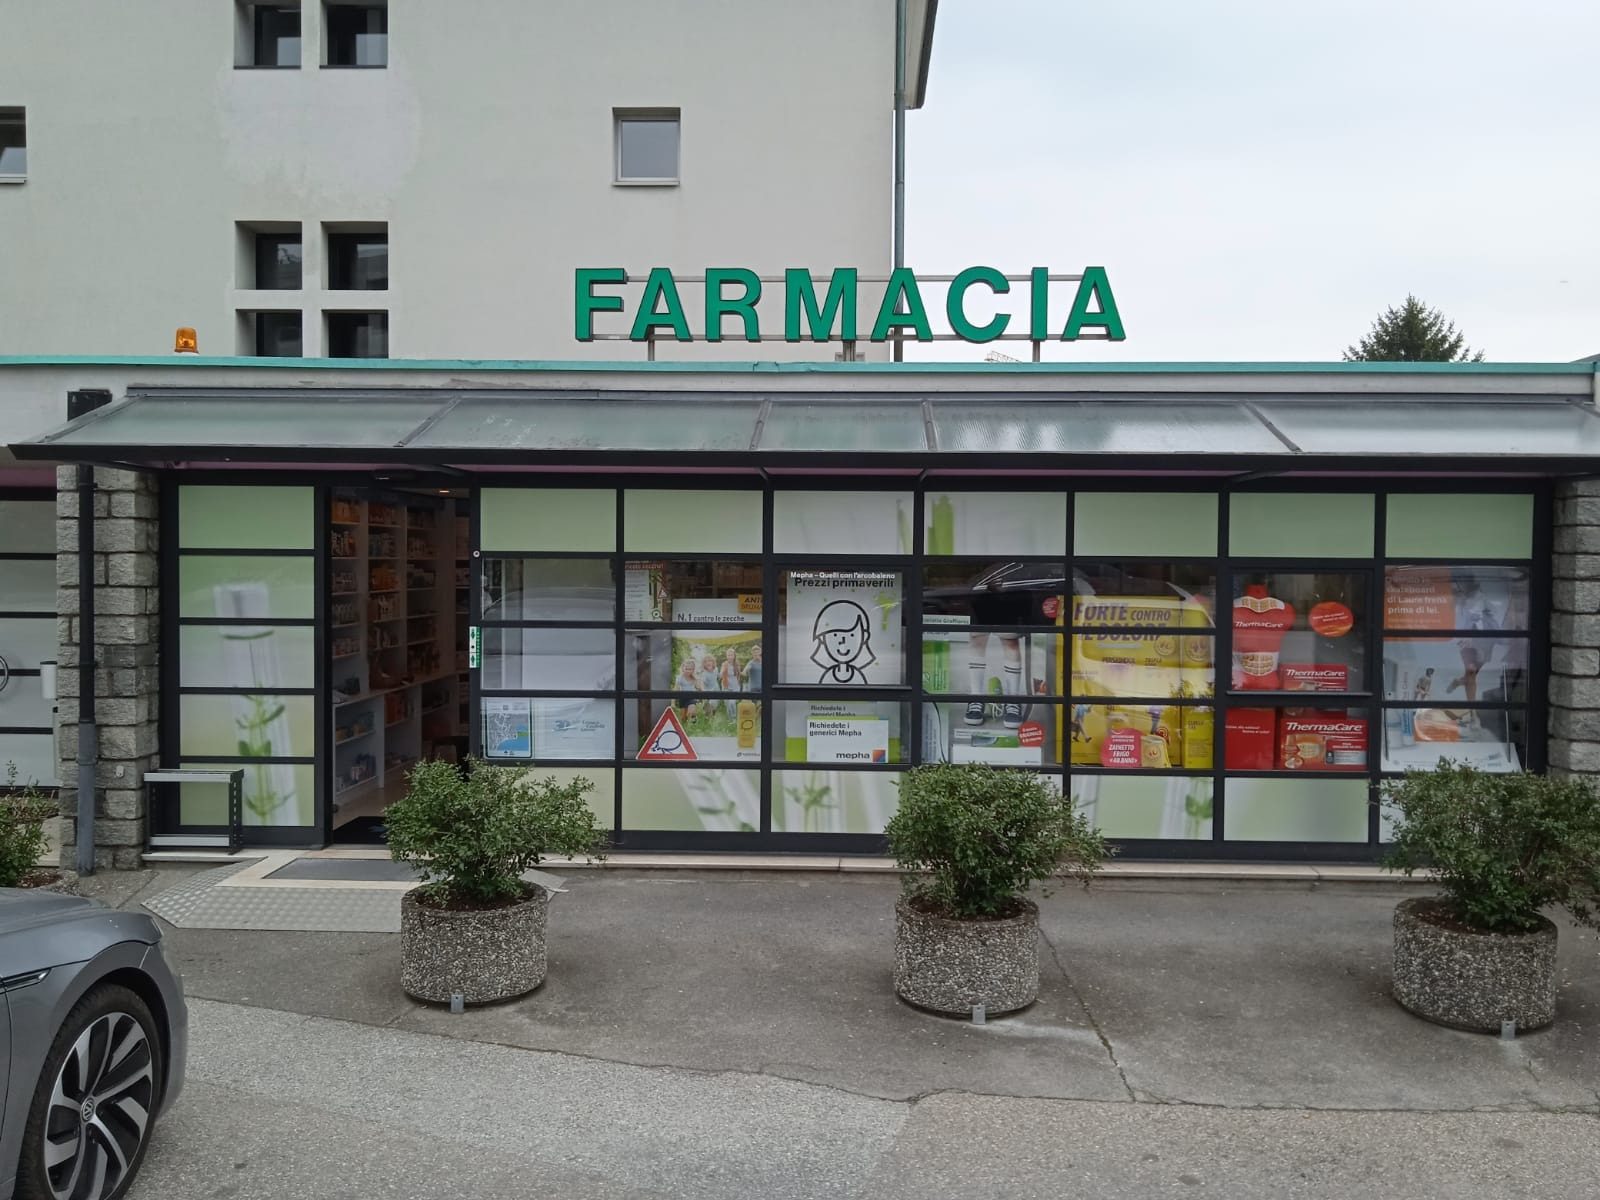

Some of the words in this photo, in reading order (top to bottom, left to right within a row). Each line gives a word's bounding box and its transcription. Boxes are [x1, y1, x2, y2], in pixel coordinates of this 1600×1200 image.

[575, 266, 1126, 343] FARMACIA
[790, 571, 813, 579] Mepha
[795, 578, 831, 587] Prezzi
[832, 578, 894, 589] primaverili
[1074, 602, 1128, 621] FORTE
[1131, 609, 1171, 621] CONTRO
[1286, 668, 1345, 677] ThermaCare
[809, 721, 846, 729] Richiedete
[1286, 721, 1363, 732] ThermaCare
[836, 752, 870, 760] mepha
